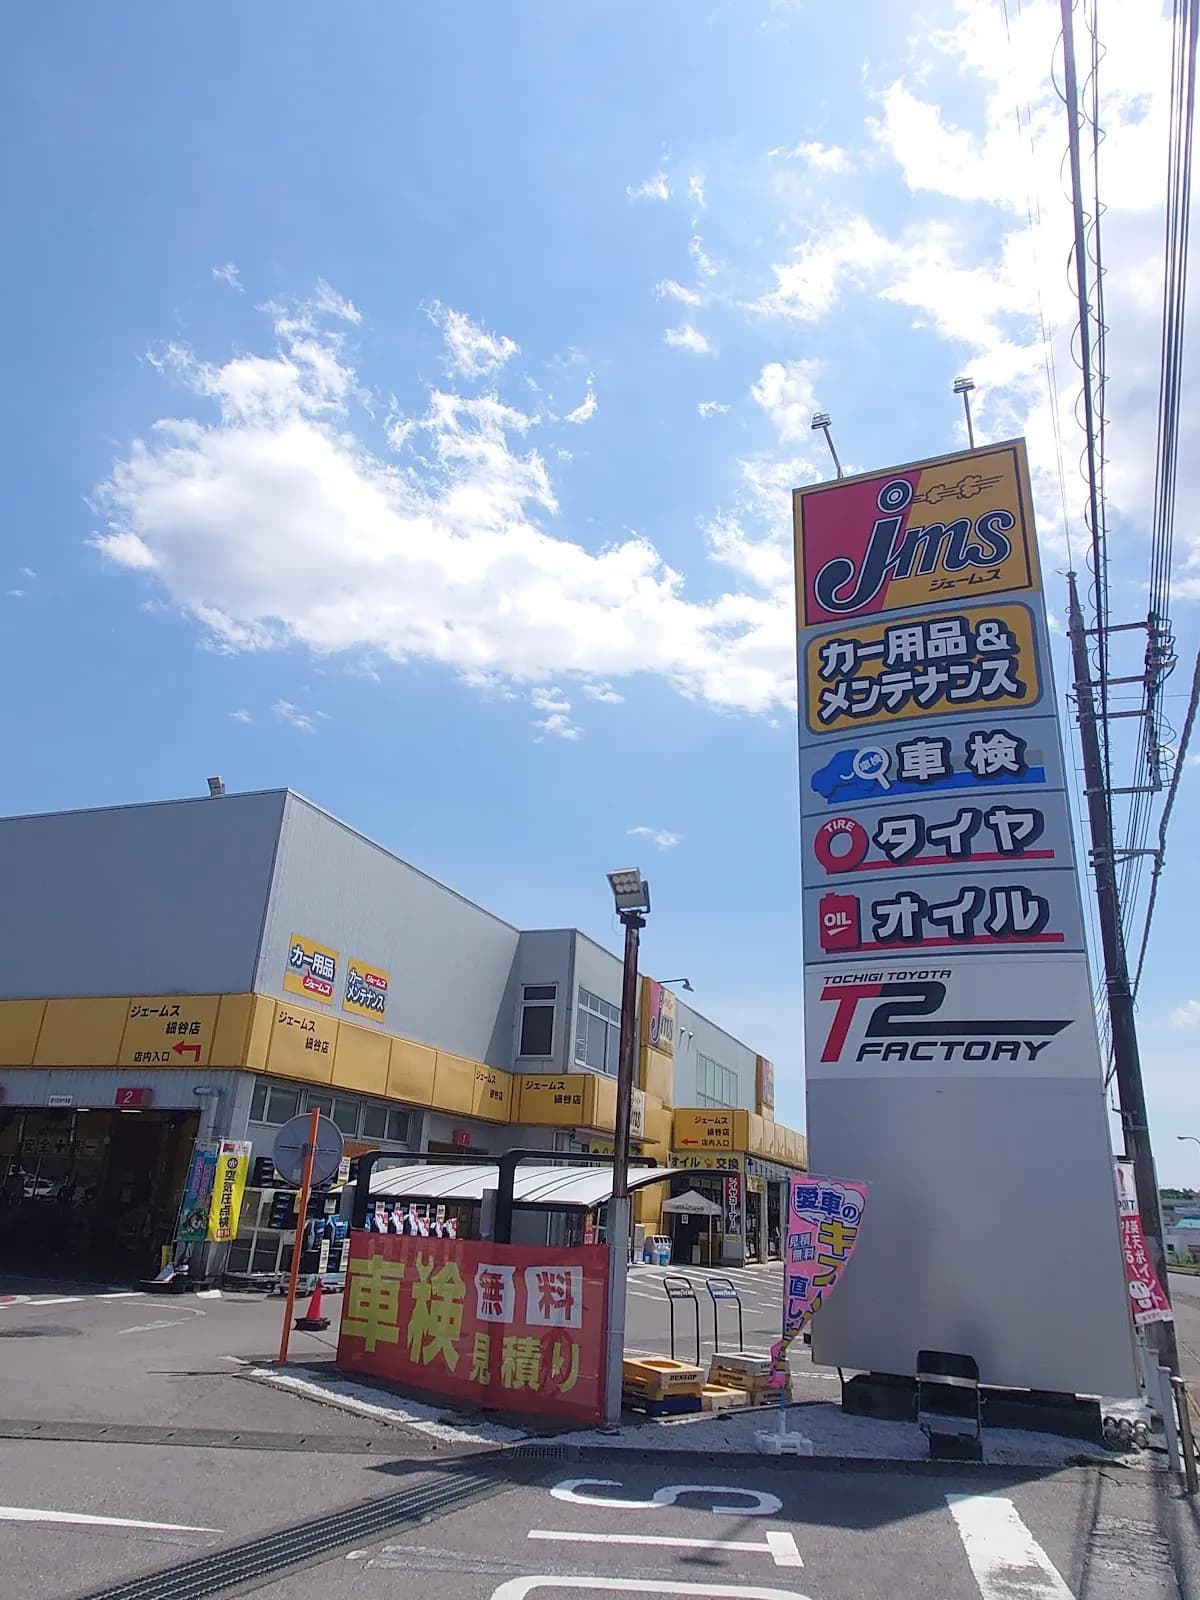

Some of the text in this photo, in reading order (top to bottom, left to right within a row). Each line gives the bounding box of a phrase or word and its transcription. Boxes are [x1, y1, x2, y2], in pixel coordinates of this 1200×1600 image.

[928, 569, 1002, 592] ジェームス
[820, 660, 1018, 720] メンテナンス
[901, 733, 1020, 781] 車検
[824, 819, 856, 833] TIRE
[877, 810, 1035, 859] タイヤ
[823, 912, 852, 927] OIL
[875, 890, 1039, 938] オイル
[291, 945, 335, 979] カー用品
[304, 979, 331, 995] ジェームス
[824, 970, 952, 985] TOCHIGI TOYOTA
[347, 985, 385, 1011] メンテナンス
[130, 1004, 181, 1018] ジェームス
[278, 1011, 316, 1033] ジェームス
[820, 981, 1075, 1063] T2
[166, 1021, 201, 1035] 細谷店
[133, 1051, 170, 1062] 店内入口
[855, 1041, 1053, 1062] FACTORY
[475, 1070, 496, 1084] ジェームス
[525, 1080, 565, 1090] ジェームス
[124, 1091, 133, 1103] 2
[694, 1115, 728, 1125] ジェームス
[671, 1156, 701, 1168] オイル
[219, 1169, 236, 1227] 空気圧点検
[796, 1185, 858, 1220] 愛車の
[479, 1268, 575, 1321] 無料
[342, 1251, 467, 1373] 車検
[469, 1332, 580, 1393] 見積り
